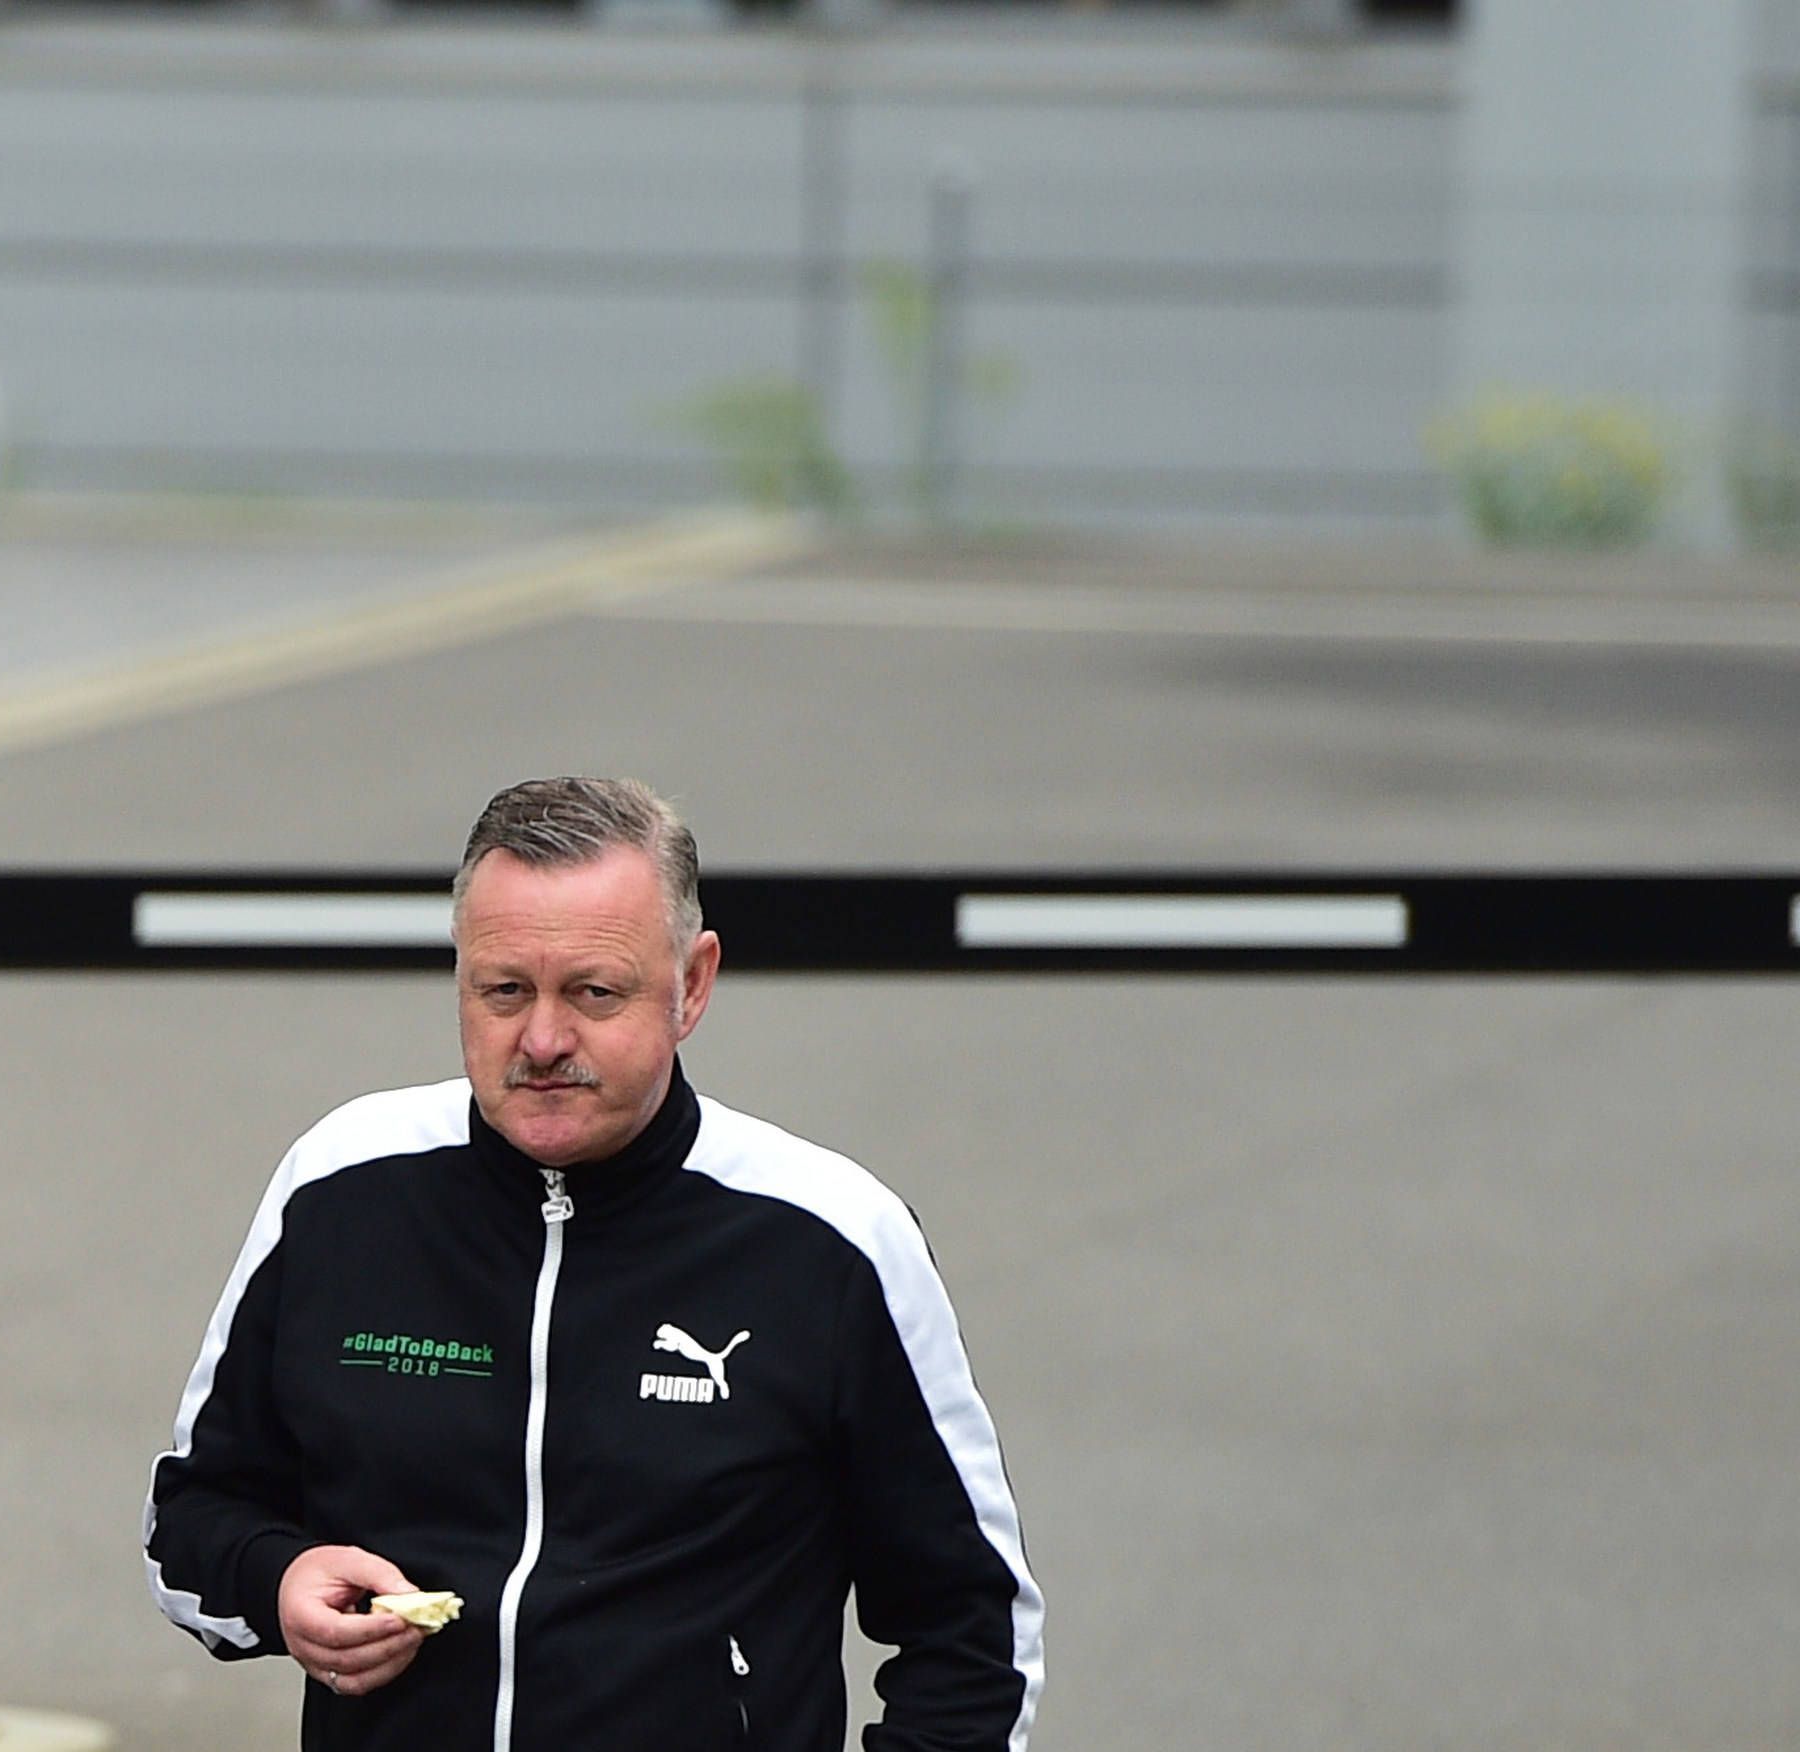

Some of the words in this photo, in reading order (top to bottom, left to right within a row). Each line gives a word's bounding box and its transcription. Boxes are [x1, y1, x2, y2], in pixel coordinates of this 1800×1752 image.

[343, 1333, 493, 1362] #GladToBeBack
[387, 1356, 440, 1376] 2018
[639, 1373, 715, 1403] PUMA
